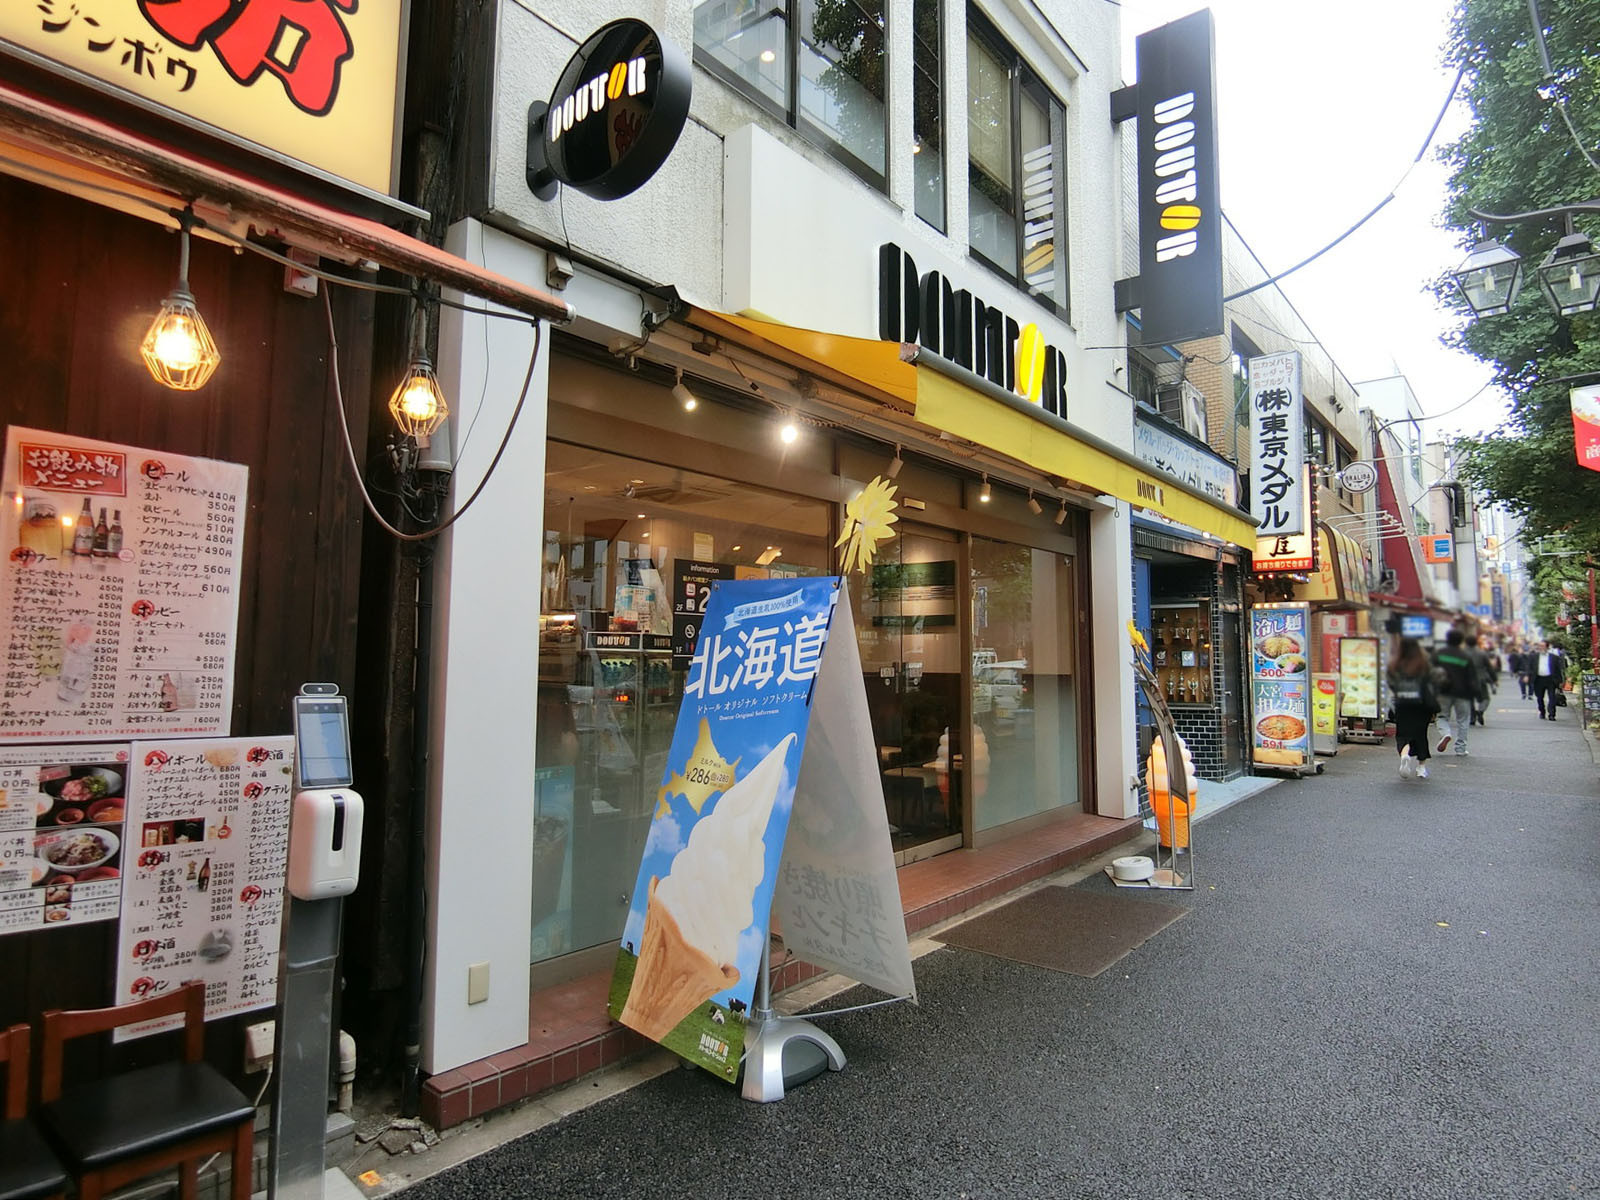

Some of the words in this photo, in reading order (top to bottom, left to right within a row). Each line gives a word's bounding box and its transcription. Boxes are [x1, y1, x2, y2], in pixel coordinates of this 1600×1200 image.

[36, 0, 197, 92] ジンボウ
[552, 56, 647, 142] DOUTOR
[1154, 91, 1202, 263] DOUTOR
[879, 242, 1068, 420] DOUTOR
[27, 449, 120, 478] お飲み物
[146, 463, 189, 482] ビール
[34, 469, 104, 488] メニュー
[208, 491, 236, 502] 440円
[207, 501, 235, 512] 350円
[207, 513, 234, 524] 560円
[206, 523, 234, 534] 510円
[205, 534, 233, 545] 480円
[204, 547, 232, 557] 490円
[203, 565, 231, 575] 560円
[690, 564, 719, 575] information
[100, 576, 124, 584] 450円
[138, 579, 180, 590] レッドアイ
[201, 584, 229, 594] 610円
[98, 602, 121, 610] 450円
[97, 611, 120, 619] 450円
[597, 635, 631, 646] DOUTOR
[685, 611, 828, 699] 北海道
[93, 664, 117, 672] 320円
[92, 682, 115, 690] 320円
[698, 702, 721, 715] ドトール
[724, 698, 758, 711] オリジナル
[762, 691, 807, 706] ソフトクリーム
[150, 754, 206, 766] ハイボール
[249, 784, 290, 799] カクテル
